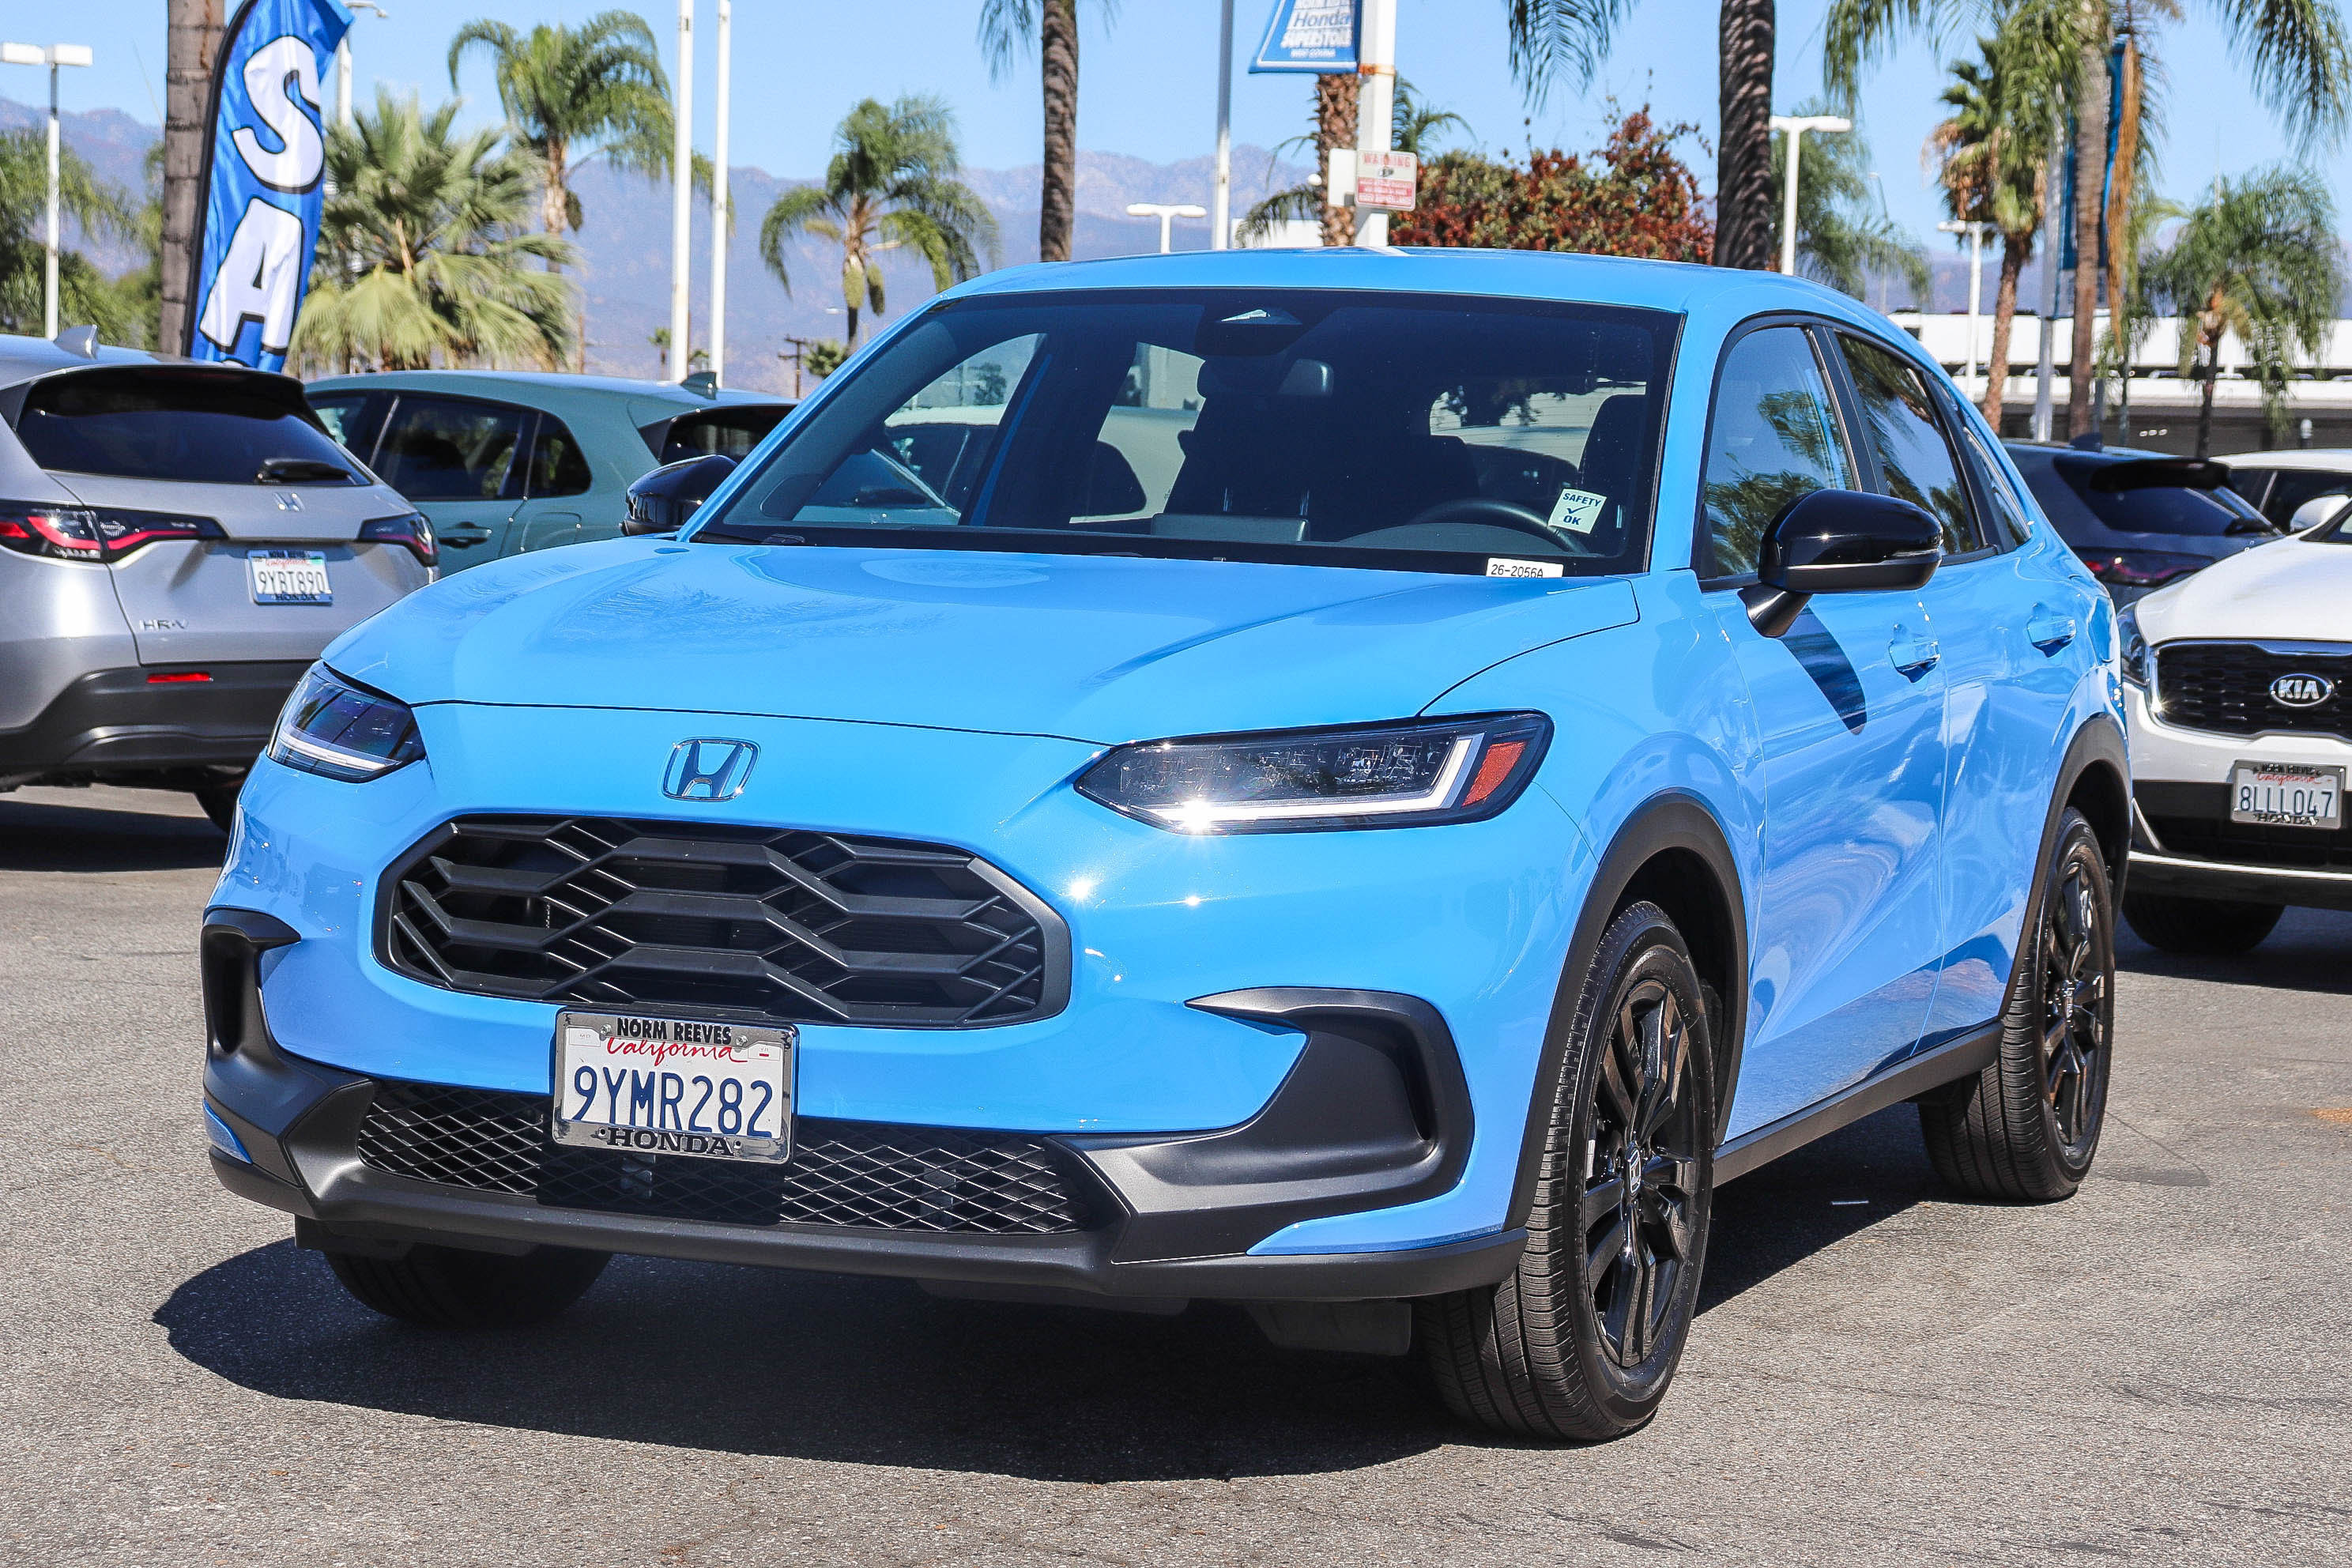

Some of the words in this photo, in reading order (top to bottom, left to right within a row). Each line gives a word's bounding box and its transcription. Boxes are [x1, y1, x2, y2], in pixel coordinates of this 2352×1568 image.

[200, 35, 325, 367] SA
[1562, 492, 1602, 507] SAFETY
[1563, 514, 1582, 526] OK
[1491, 564, 1544, 579] 26-2056A
[2278, 680, 2320, 699] KIA
[2241, 786, 2333, 817] 8LLL047
[616, 1017, 668, 1040] NORM
[673, 1023, 733, 1045] REEVES
[607, 1037, 748, 1067] California
[572, 1065, 773, 1138] 9YMR282
[606, 1126, 736, 1157] HONDA
